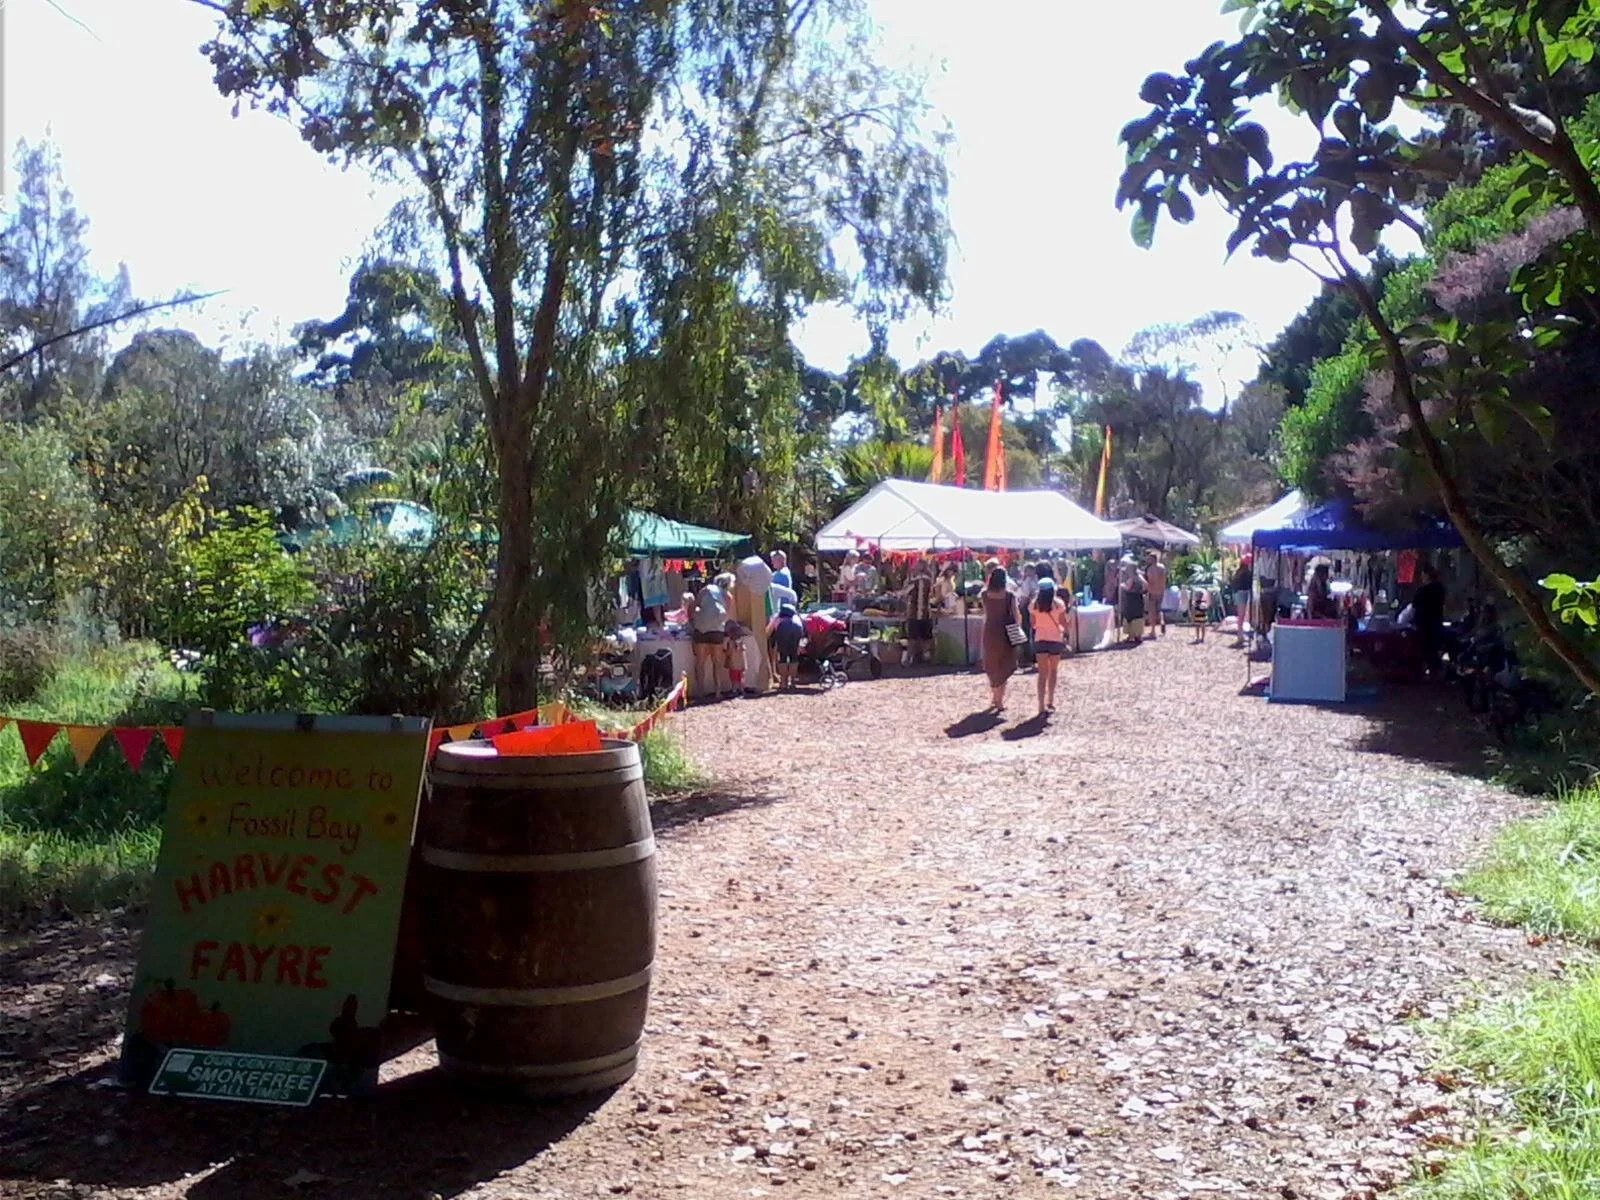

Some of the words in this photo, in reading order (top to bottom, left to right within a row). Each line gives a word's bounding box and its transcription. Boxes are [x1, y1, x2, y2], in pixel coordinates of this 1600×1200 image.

[369, 764, 394, 791] to
[227, 802, 297, 838] Fossil
[306, 805, 362, 855] Bay
[173, 852, 379, 914] HARVEST
[190, 940, 333, 989] FAYRE
[187, 1065, 314, 1091] SMOKEFREE
[195, 1082, 217, 1094] AT
[220, 1083, 244, 1097] ALL
